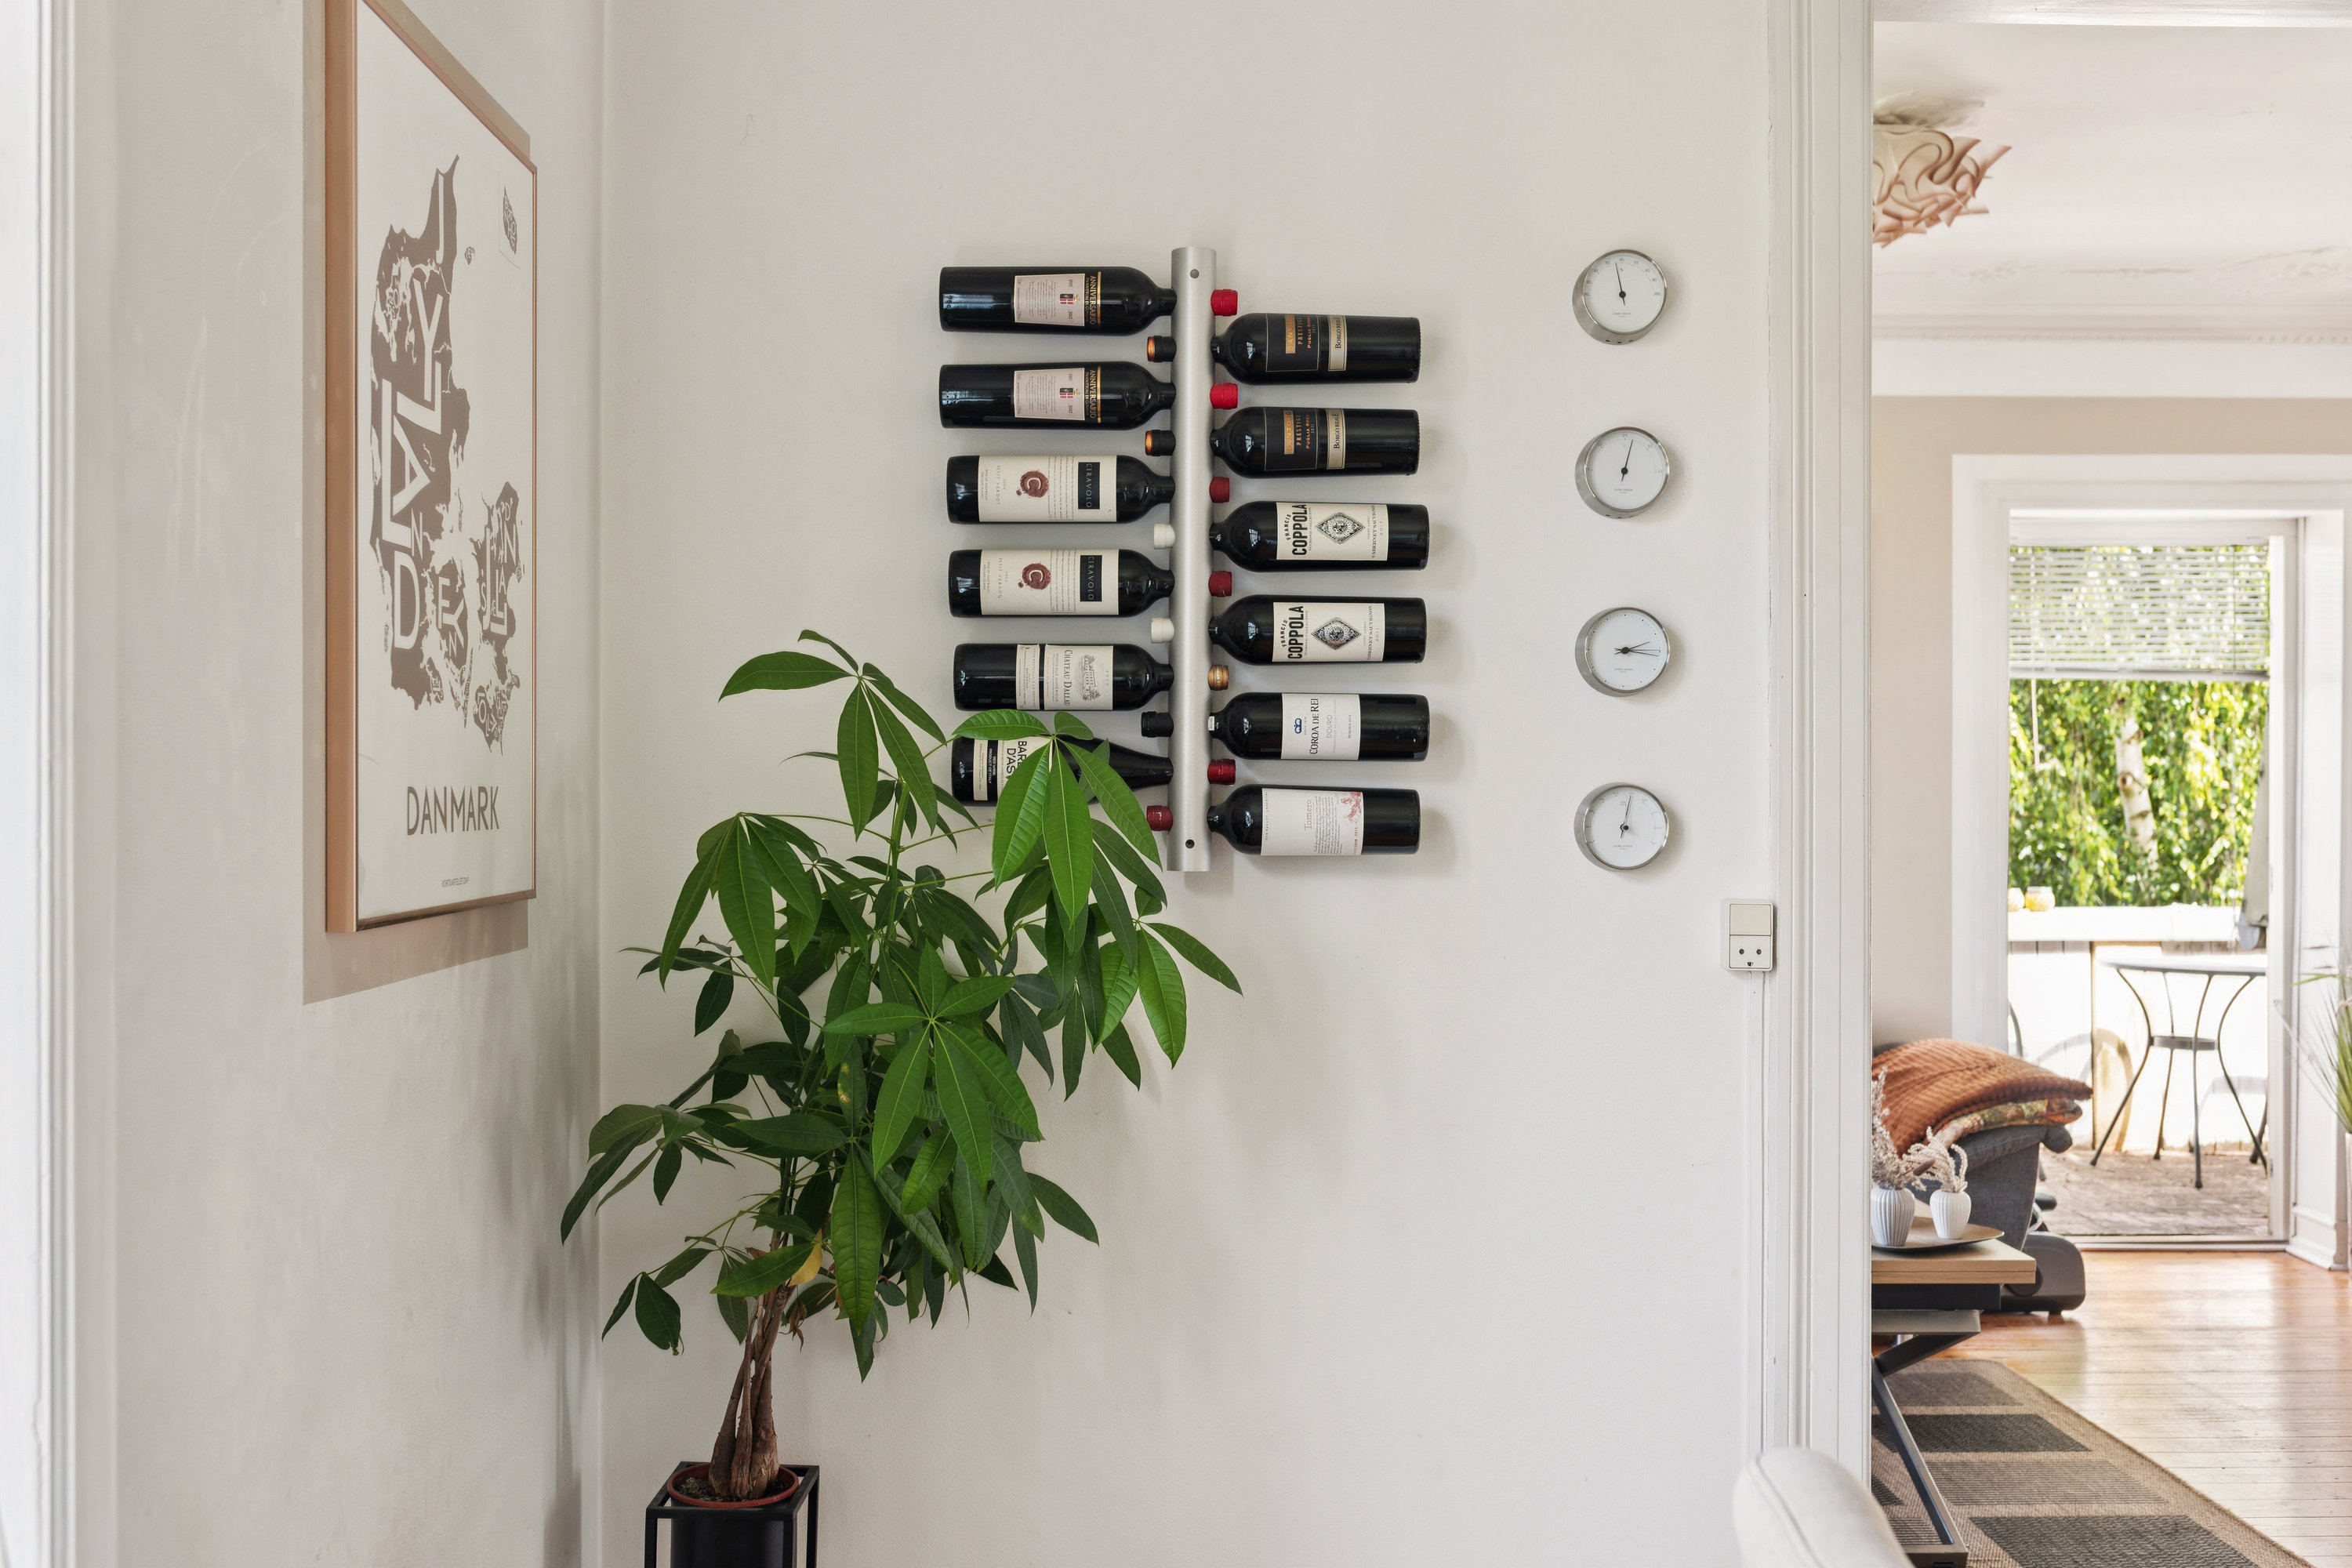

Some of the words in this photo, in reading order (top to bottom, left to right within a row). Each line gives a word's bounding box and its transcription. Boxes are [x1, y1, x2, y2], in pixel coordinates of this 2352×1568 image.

[1292, 505, 1308, 555] COPPOLA
[1287, 606, 1304, 659] COPPOLA
[1064, 650, 1073, 679] CHATEAU
[1064, 682, 1073, 706] DALLAU
[1310, 699, 1319, 712] REI
[1313, 714, 1319, 724] DE
[1309, 727, 1319, 754] COROA
[1007, 749, 1016, 774] D'AS
[407, 786, 499, 836] DANMARK
[1304, 800, 1312, 831] Tomero
